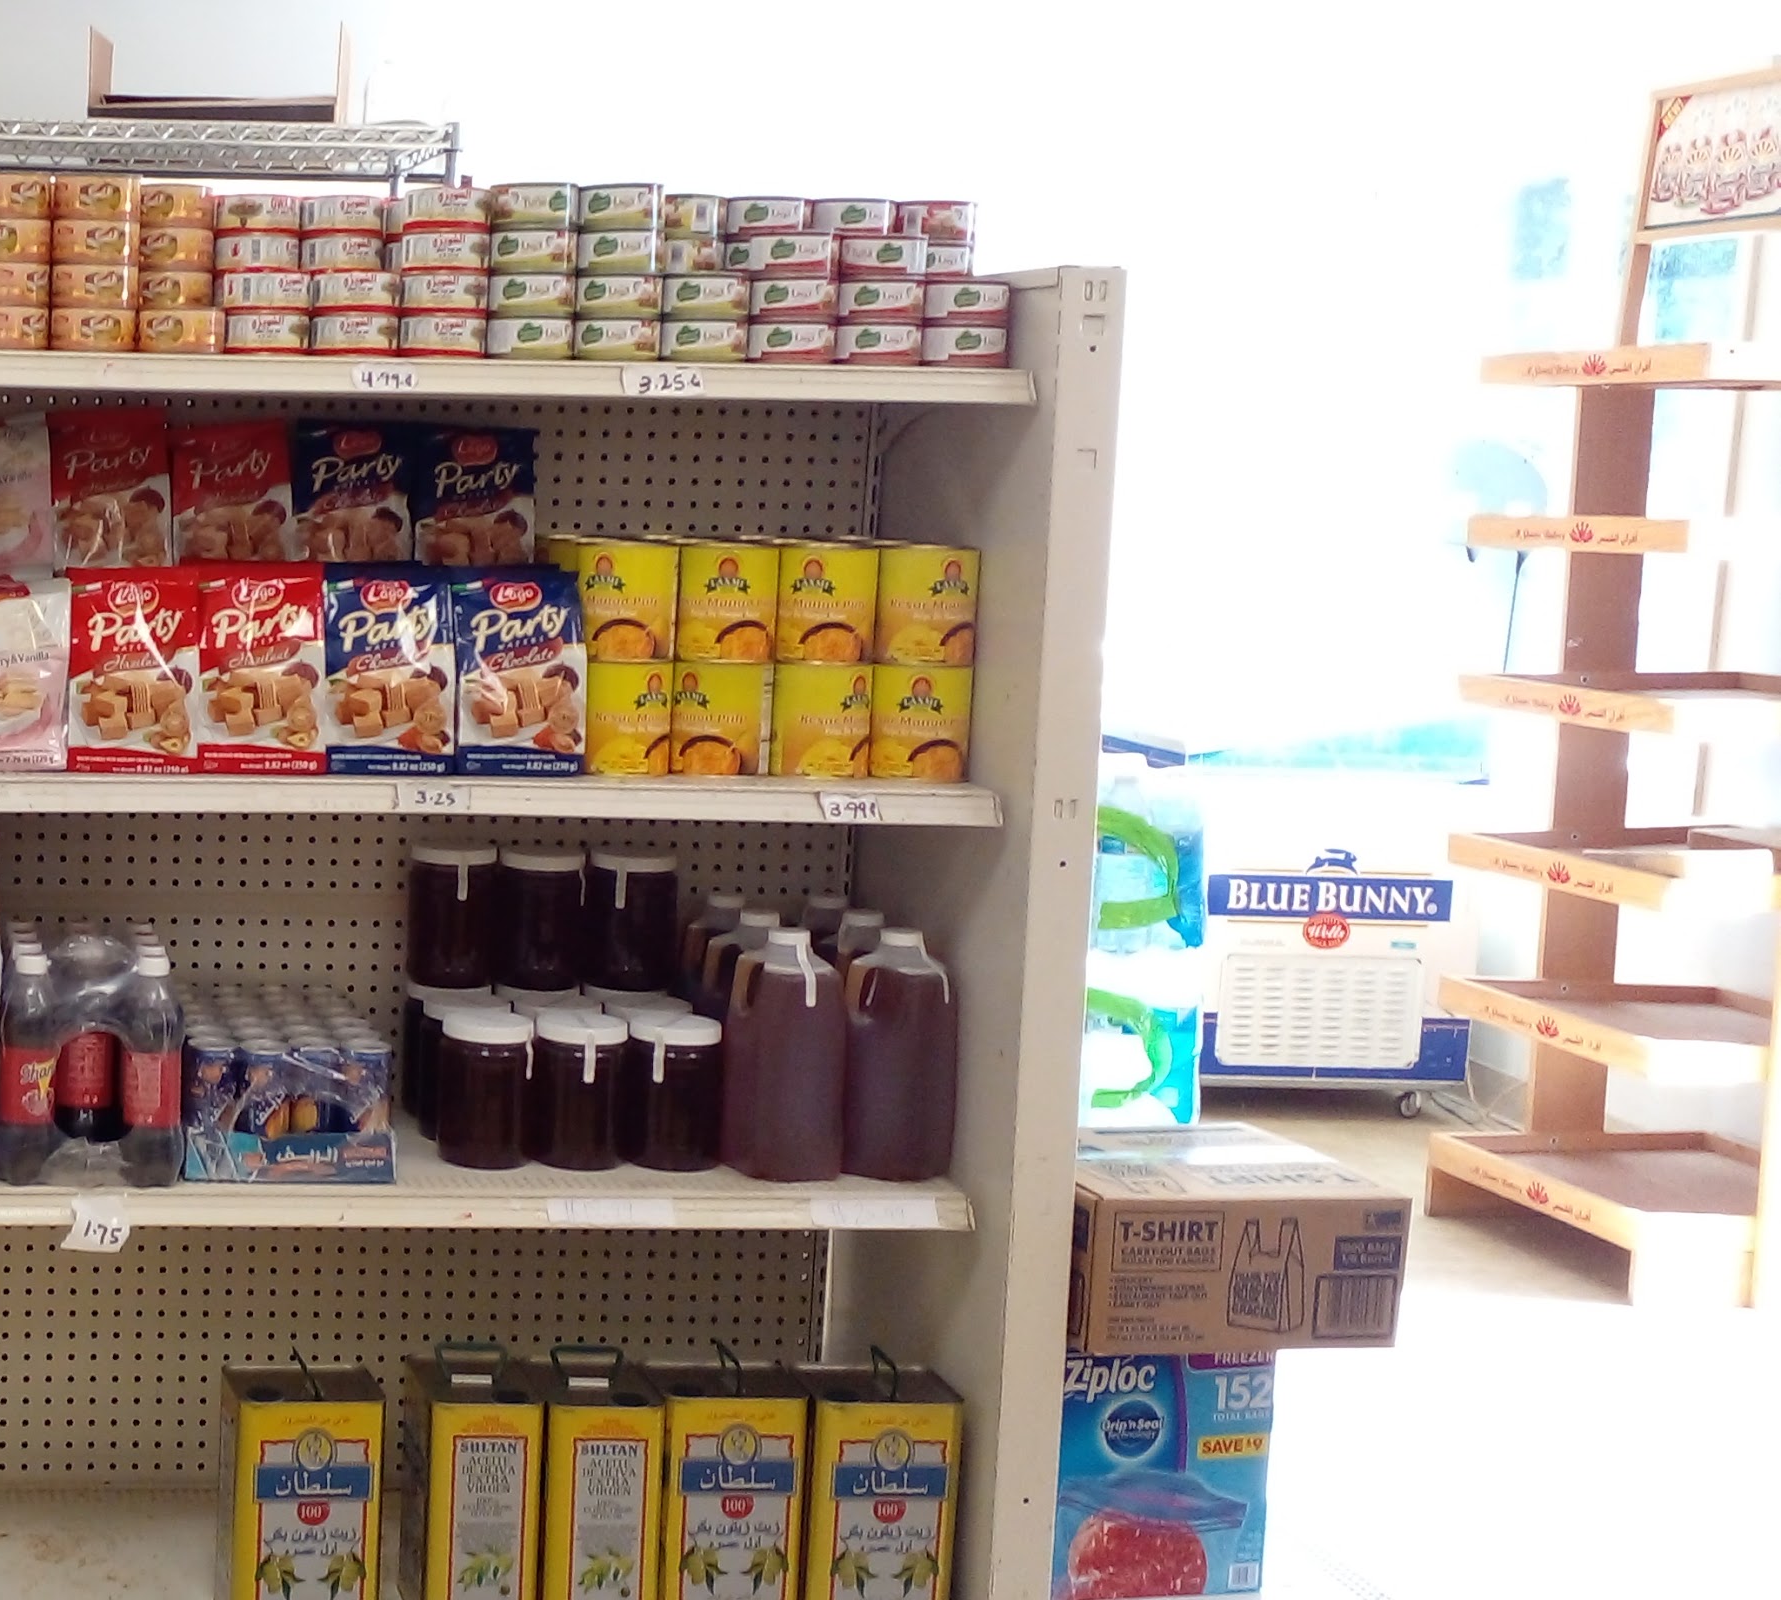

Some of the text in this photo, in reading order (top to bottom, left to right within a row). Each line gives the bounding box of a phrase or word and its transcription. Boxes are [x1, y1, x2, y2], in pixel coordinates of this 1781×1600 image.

[64, 447, 152, 480] Party
[189, 451, 272, 488] Party
[312, 453, 401, 493] Party
[434, 459, 521, 498] Party
[366, 585, 406, 604] Lago
[496, 586, 536, 606] Lago
[710, 577, 747, 591] LAXMI
[796, 578, 832, 592] LAXMI
[87, 609, 184, 652] Party
[211, 603, 309, 649] Party
[339, 605, 435, 652] Party
[471, 607, 569, 652] Party
[488, 648, 555, 672] Chocolate
[903, 693, 940, 707] LAXMI
[415, 791, 457, 806] 3.25
[1228, 878, 1311, 912] BLUE
[83, 1218, 123, 1246] 1.75
[1119, 1220, 1219, 1242] T-SHIRT
[1064, 1355, 1157, 1404] Ziploc
[1215, 1372, 1274, 1412] 152
[459, 1441, 517, 1455] SULTAN
[580, 1443, 638, 1457] SULTAN
[1202, 1438, 1243, 1454] SAVE
[275, 1470, 353, 1497] سلطان
[466, 1474, 509, 1485] EXTRA
[699, 1464, 776, 1490] سلطان
[852, 1470, 929, 1496] سلطان
